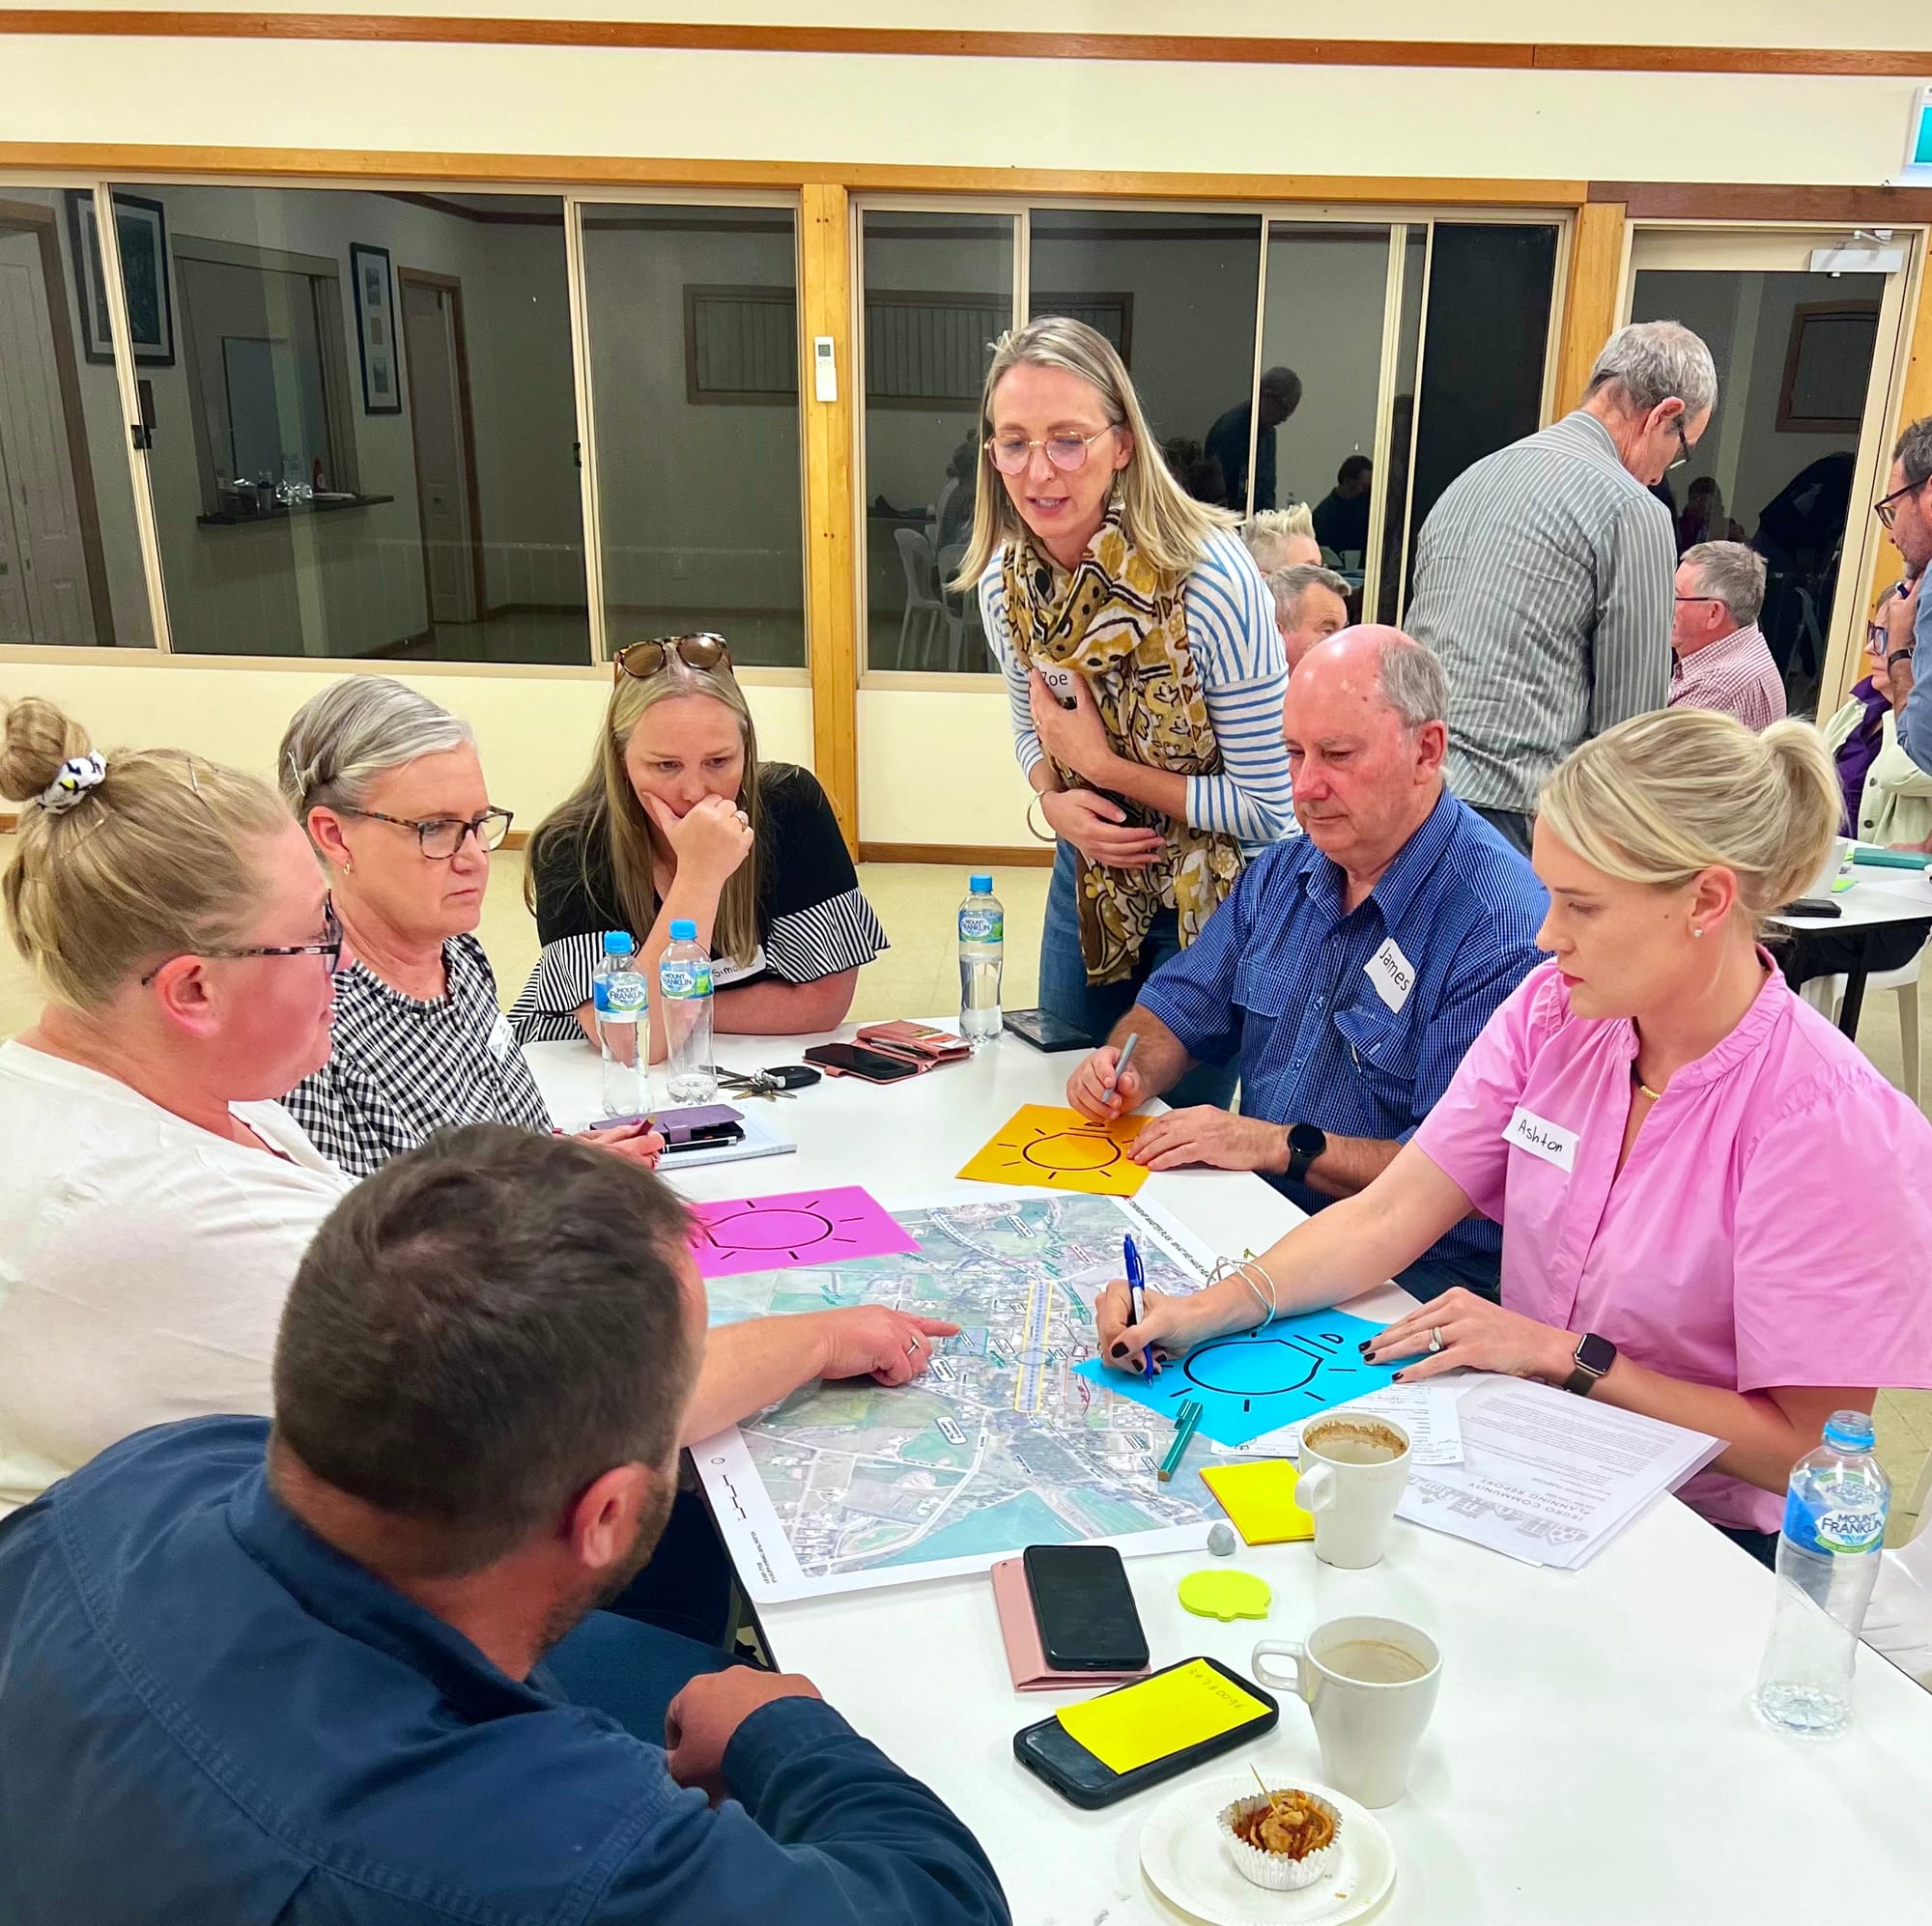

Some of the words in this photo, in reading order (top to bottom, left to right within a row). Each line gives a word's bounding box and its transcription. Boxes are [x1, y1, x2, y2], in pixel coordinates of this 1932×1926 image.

[1379, 947, 1409, 991] James
[610, 990, 644, 1001] FRANKLIN
[1518, 1119, 1563, 1152] Ashton
[1468, 1482, 1542, 1509] COMMUNITY
[1480, 1478, 1525, 1496] REPORT
[1528, 1492, 1591, 1516] PLANNING
[1821, 1516, 1883, 1535] FRANKLIN
[1837, 1512, 1878, 1524] MOUNT
